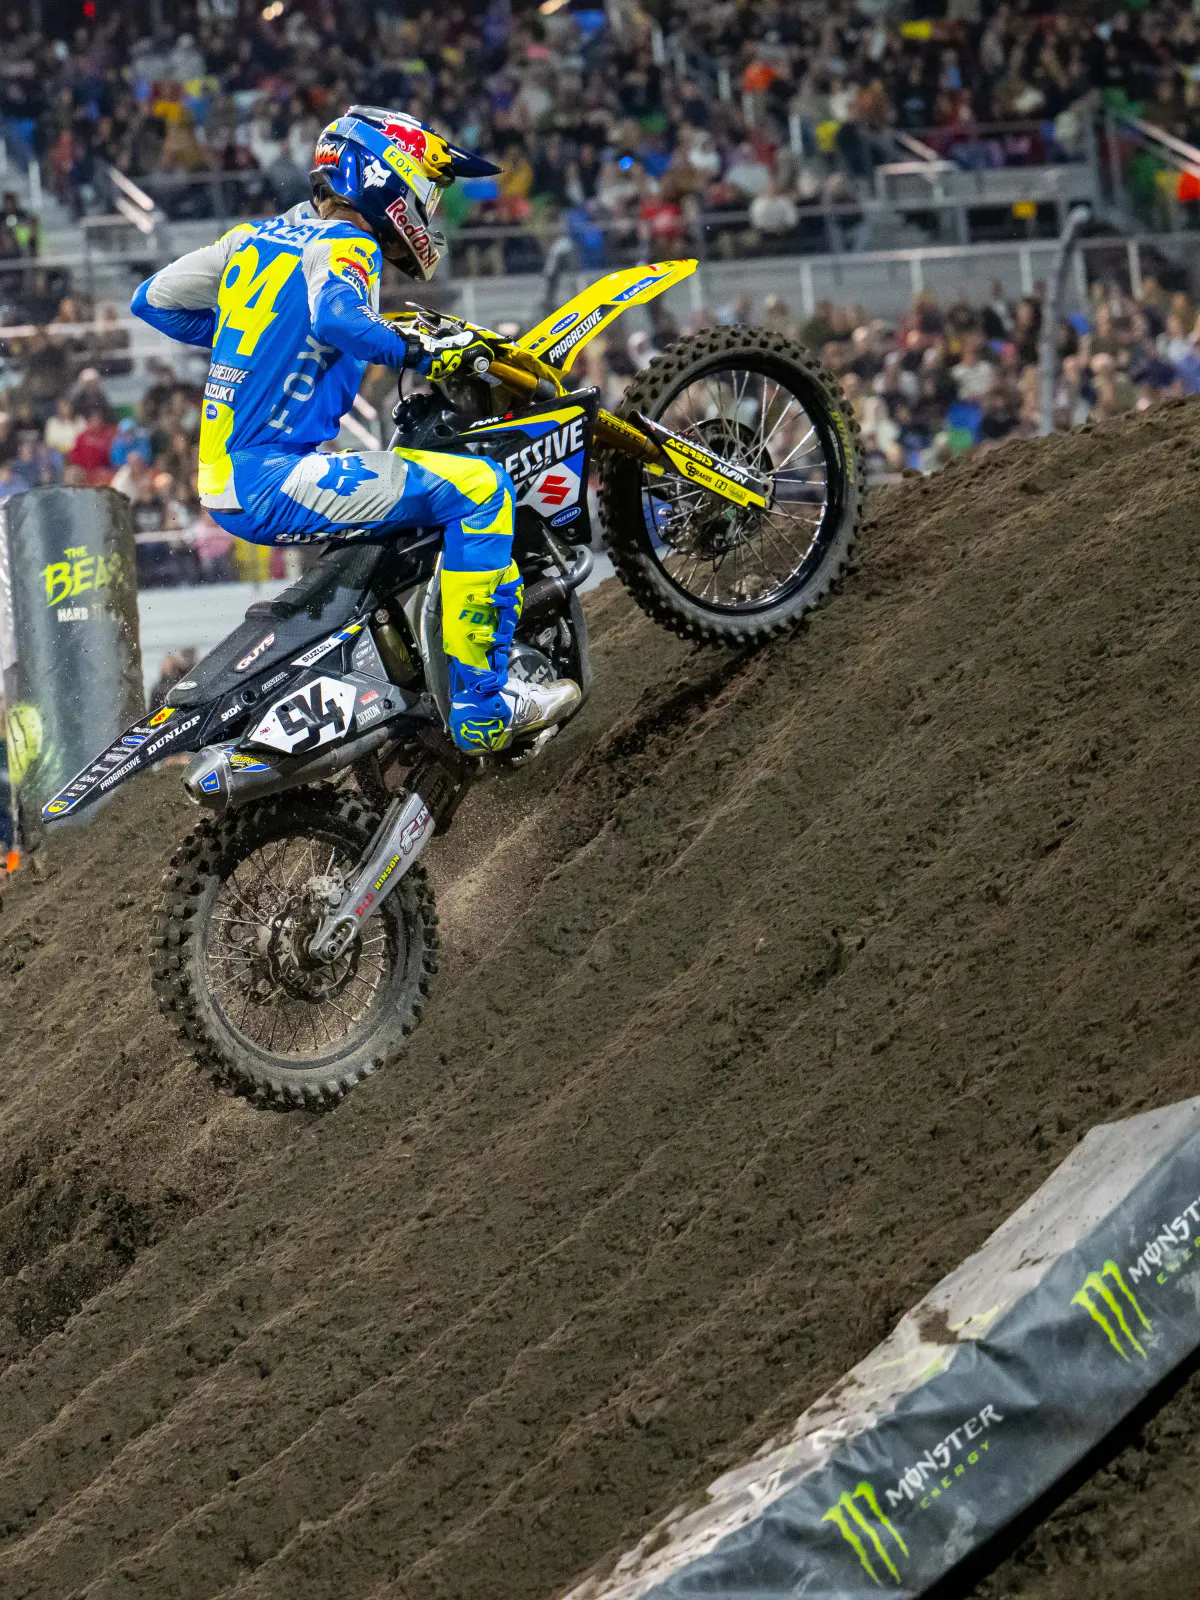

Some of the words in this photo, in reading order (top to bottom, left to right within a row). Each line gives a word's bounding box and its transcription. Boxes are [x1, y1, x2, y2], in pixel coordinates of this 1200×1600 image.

[387, 150, 413, 178] FOX
[386, 197, 426, 238] Red
[212, 244, 302, 356] 94
[548, 308, 603, 364] PROGRESSIVE
[204, 382, 236, 402] UZUKI
[498, 418, 584, 481] ESSIVE
[63, 544, 88, 560] THE
[40, 553, 124, 608] BEA
[235, 632, 276, 671] GUTS
[302, 641, 333, 664] SUZUKI
[220, 704, 242, 722] SKDA
[275, 682, 346, 753] 94
[146, 715, 201, 756] DUNLOP
[100, 755, 142, 791] PROGRESSIVE
[374, 854, 401, 891] HINSON
[1128, 1195, 1200, 1284] MONST
[885, 1403, 1004, 1507] MONSTER
[920, 1440, 990, 1510] ENERGY
